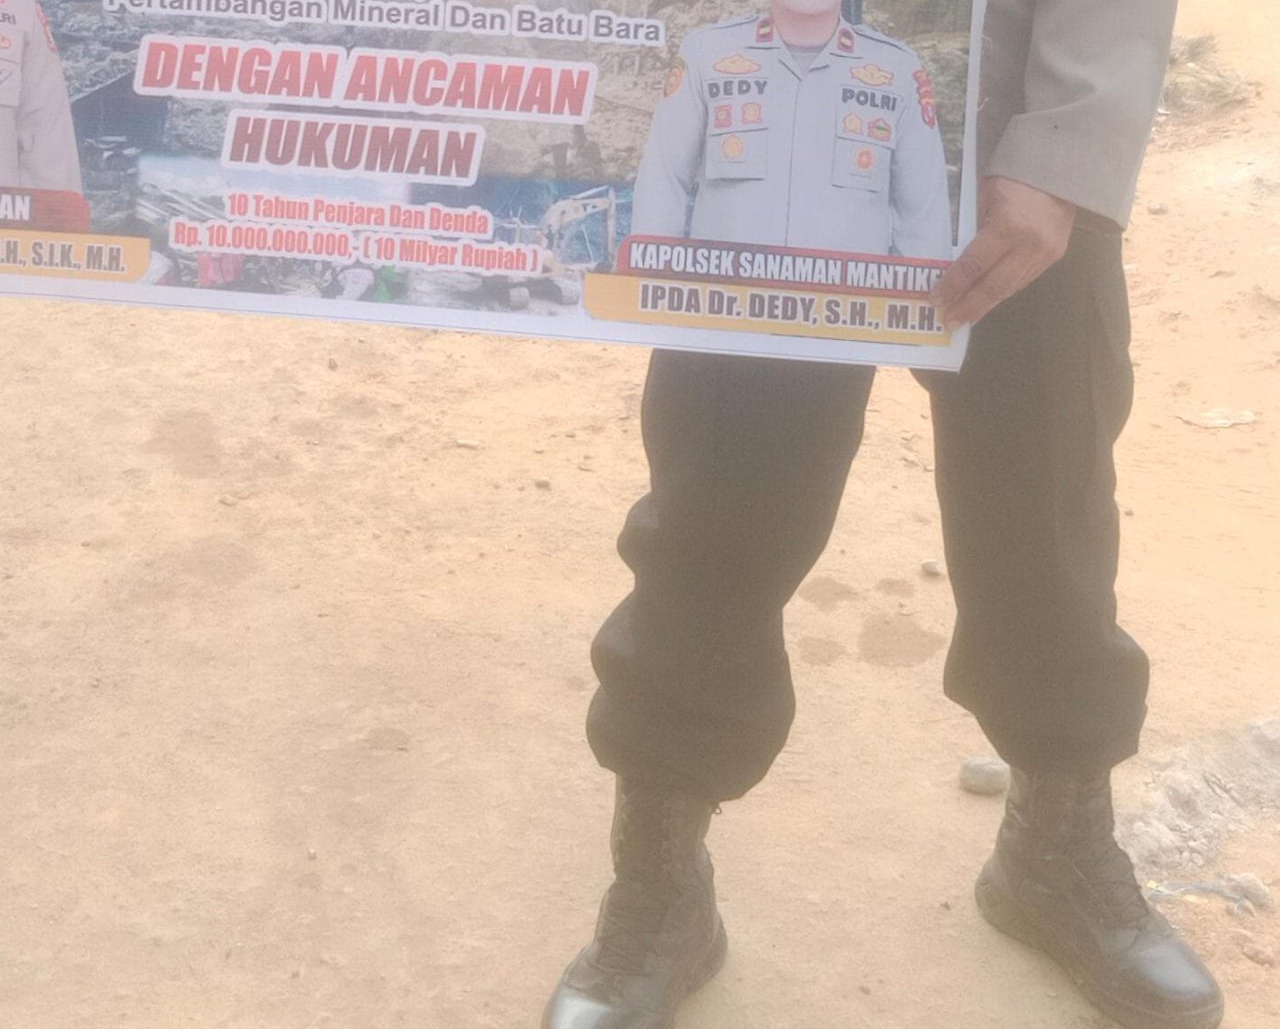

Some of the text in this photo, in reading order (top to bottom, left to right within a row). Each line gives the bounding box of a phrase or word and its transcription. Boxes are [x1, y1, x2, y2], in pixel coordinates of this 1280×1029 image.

[450, 6, 506, 31] Dan
[517, 11, 583, 37] Batu
[593, 15, 661, 41] Bara
[141, 41, 590, 117] DENGAN ANCAMAN
[708, 80, 768, 99] DEDY
[841, 88, 898, 112] POLRI
[229, 116, 478, 178] HUKUMAN
[228, 193, 489, 235] 10 Tahun Penjara Dan Denda
[86, 245, 125, 273] M.H.
[174, 222, 201, 248] Rp.
[400, 239, 458, 266] Milyar
[630, 243, 944, 292] KAPOLSEK SANAMAN MANTIKE
[641, 284, 702, 313] IPDA
[708, 287, 741, 316] Dr.
[749, 293, 818, 325] DEDY,
[887, 304, 942, 332] M.H.
